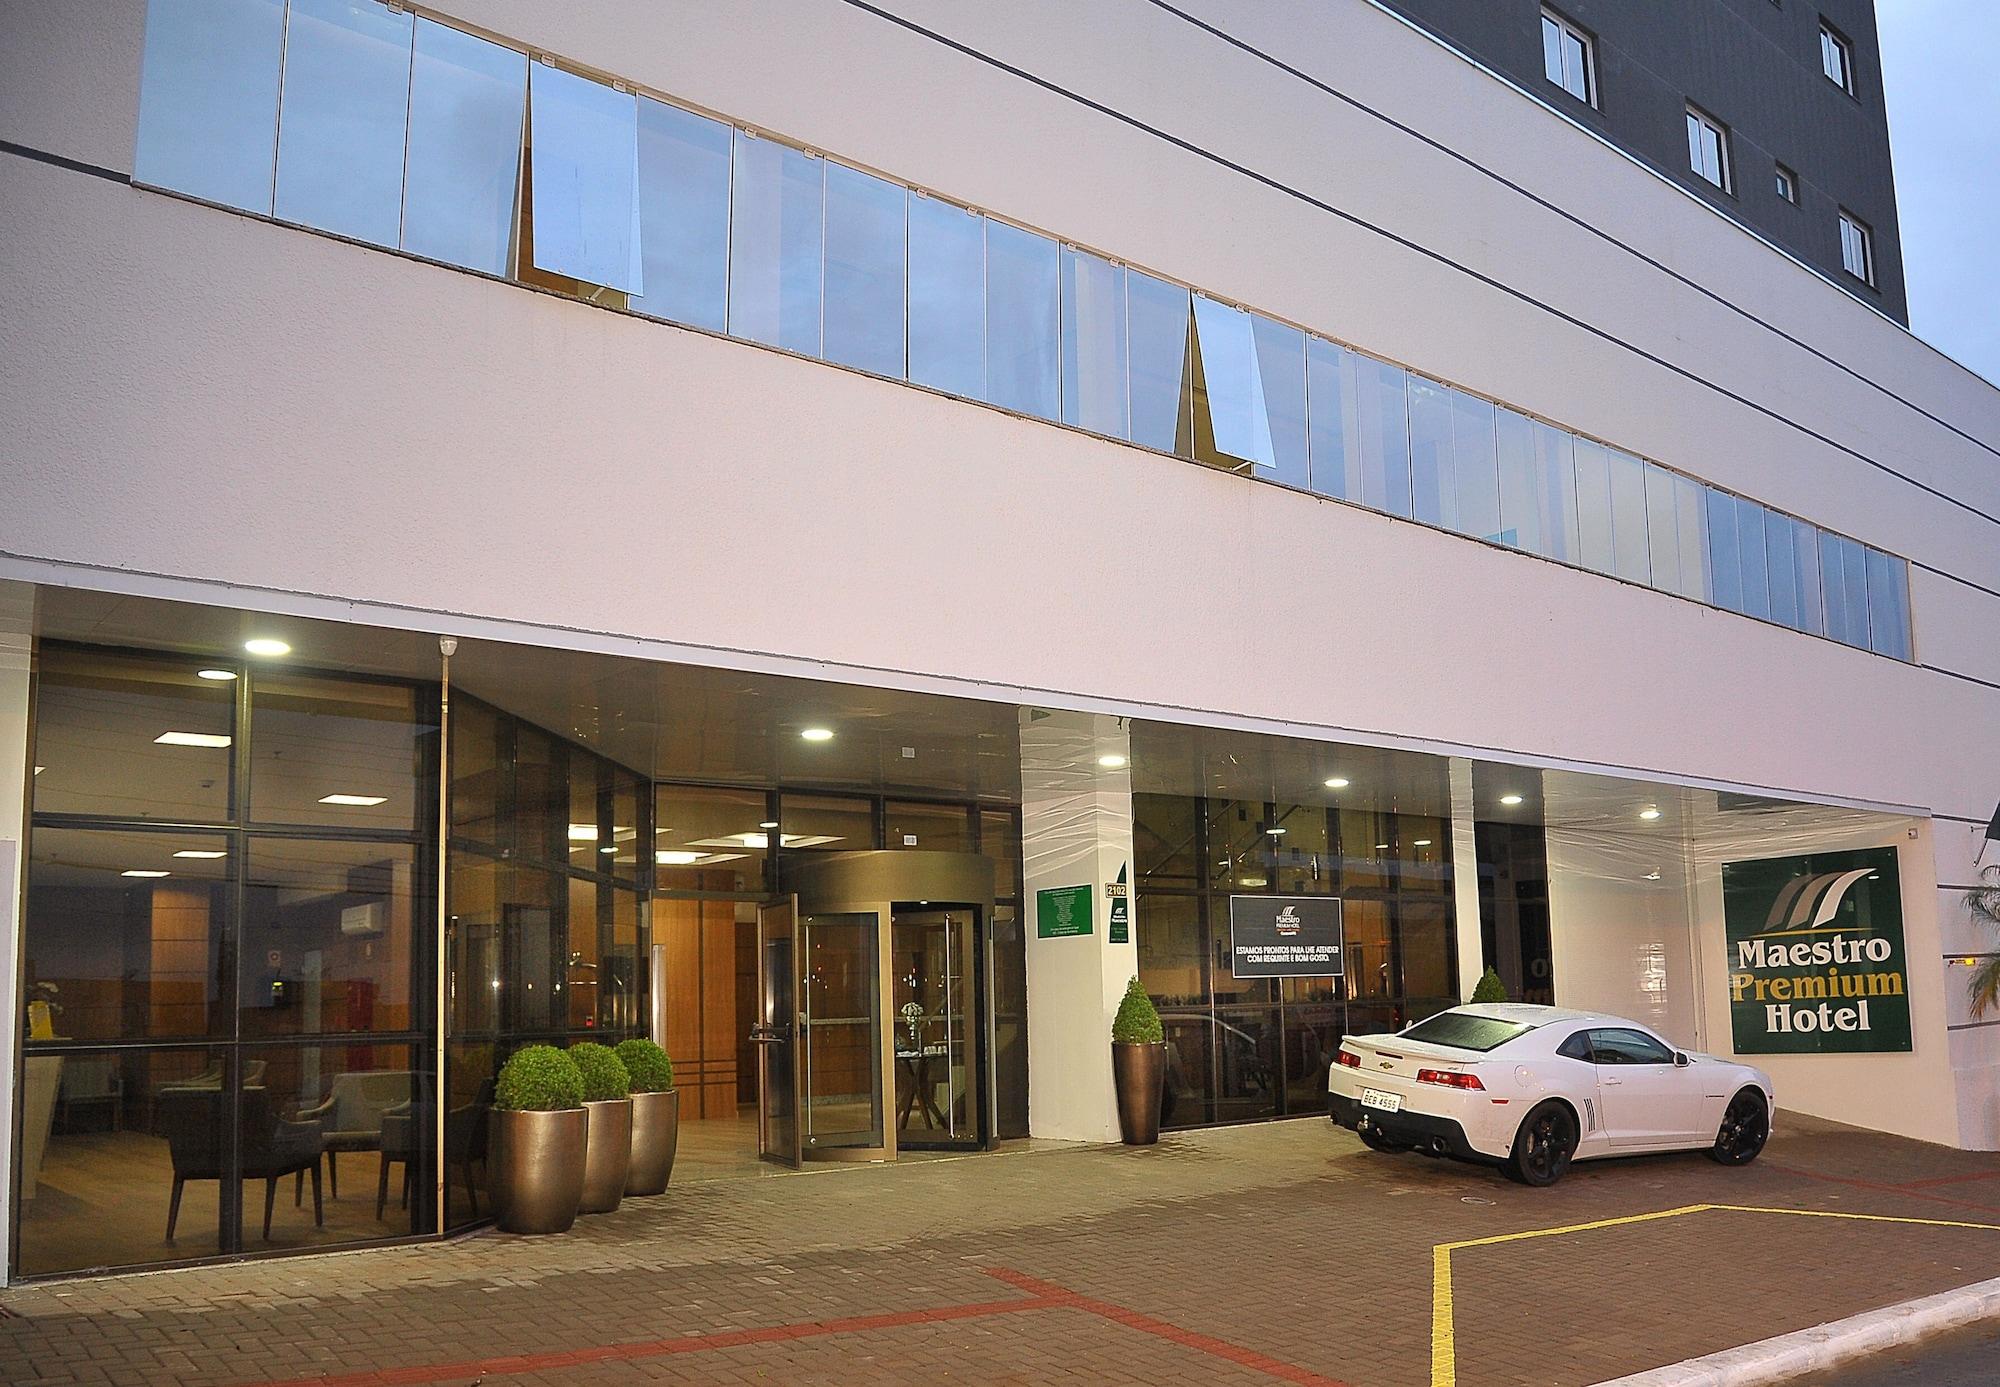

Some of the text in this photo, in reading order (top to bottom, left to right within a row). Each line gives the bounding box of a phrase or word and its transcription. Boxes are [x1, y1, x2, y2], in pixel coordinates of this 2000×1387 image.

[1108, 886, 1126, 896] 2102
[1236, 946, 1339, 955] ESTAMOS PRONTOS PARA LHE ATENDER
[1247, 955, 1262, 963] COM
[1737, 933, 1892, 969] Maestro
[1731, 967, 1904, 1002] Premium
[1765, 1000, 1871, 1033] Hotel
